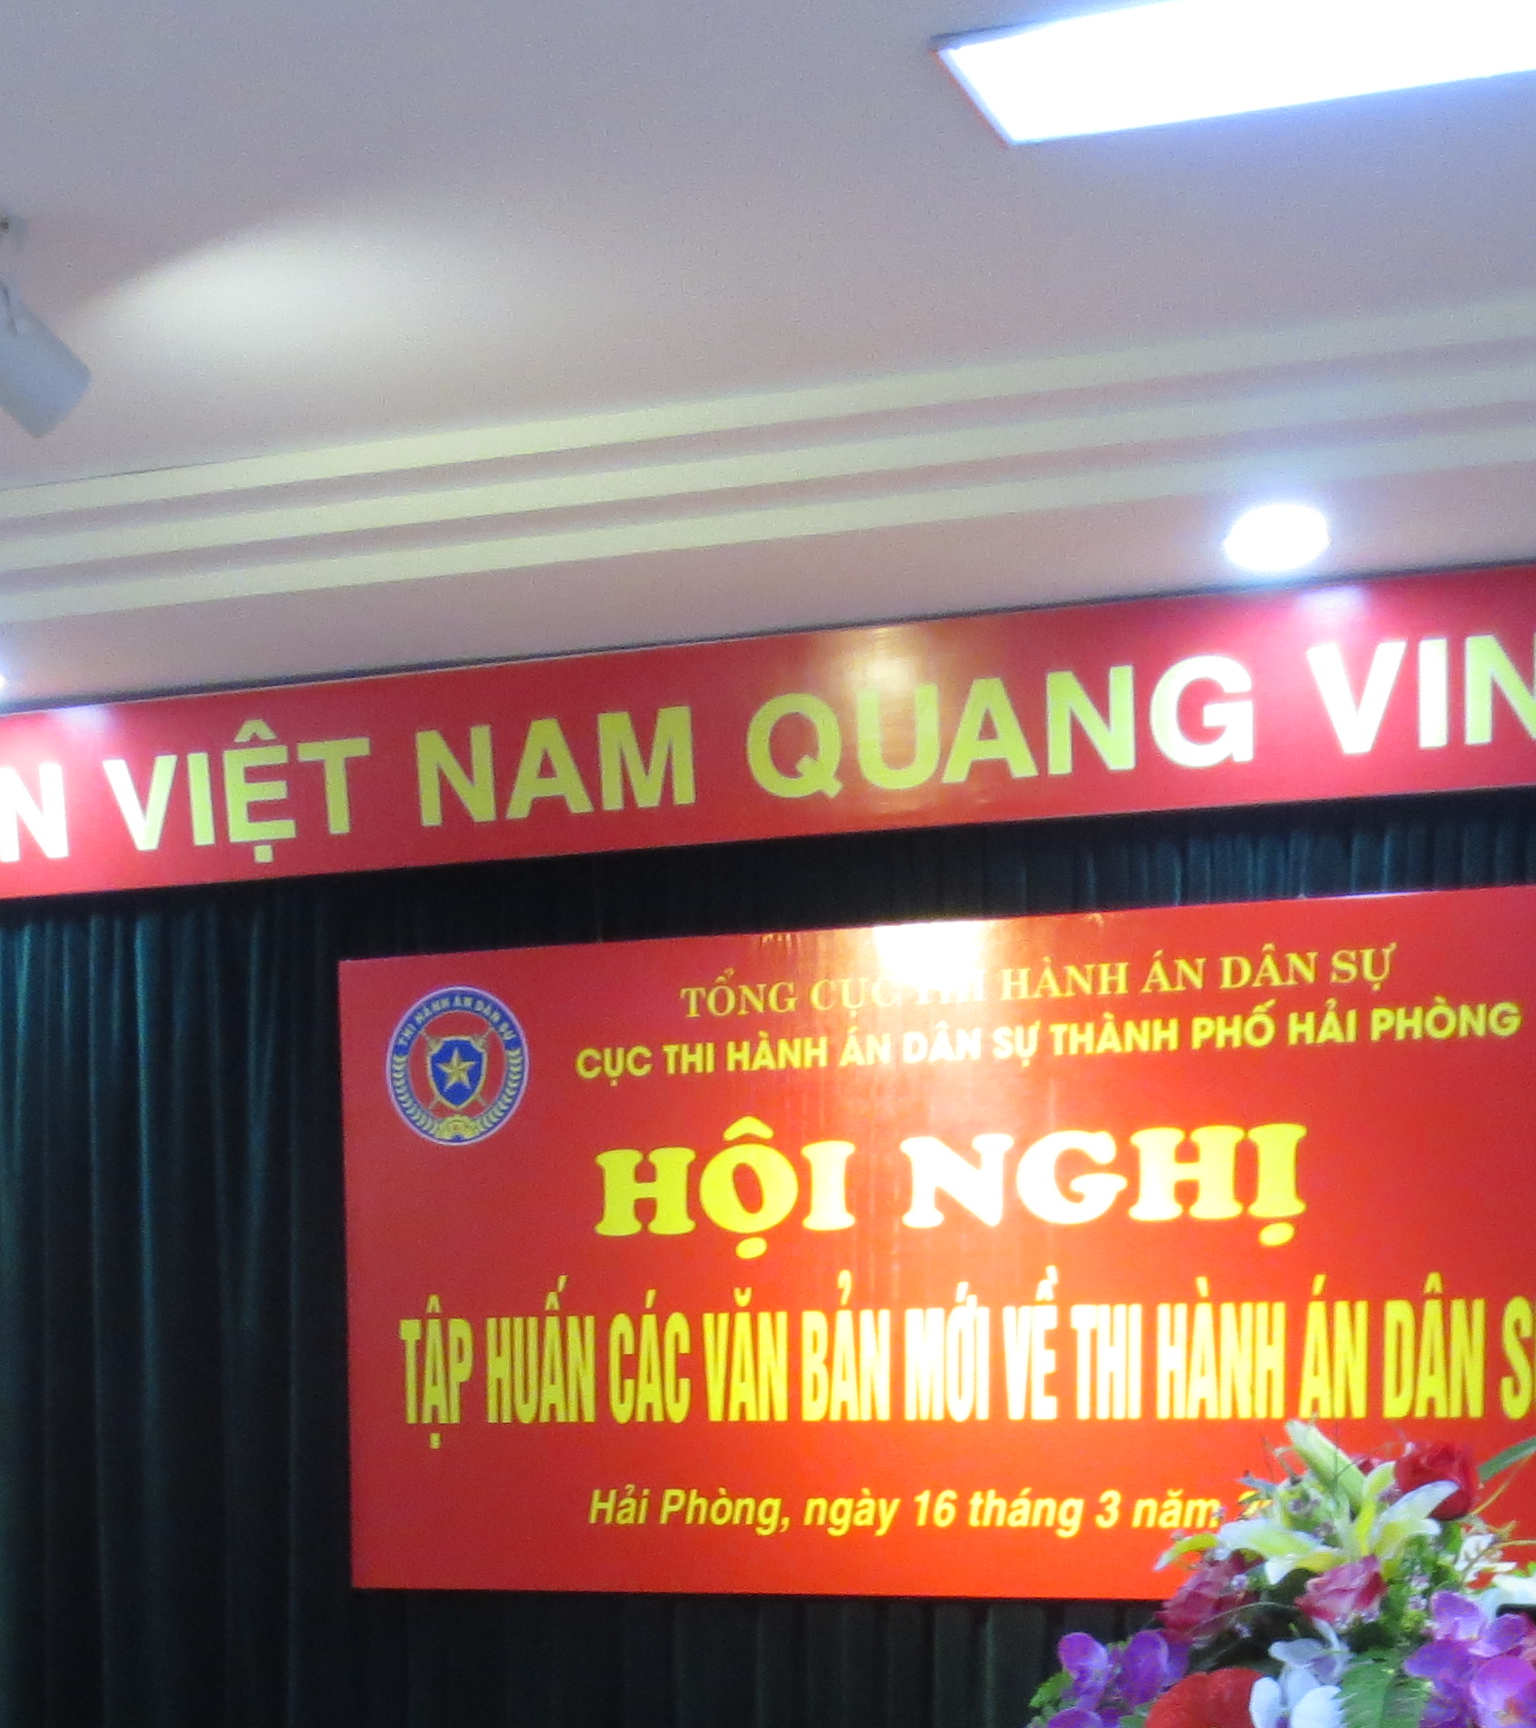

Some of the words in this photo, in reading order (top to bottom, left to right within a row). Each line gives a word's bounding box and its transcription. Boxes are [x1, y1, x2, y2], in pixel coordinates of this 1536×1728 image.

[103, 717, 371, 863] VIỆT
[415, 705, 697, 829] NAM
[746, 655, 1257, 801] QUANG
[680, 967, 798, 1018] TỔNG
[809, 974, 902, 1019] CỤC
[1000, 955, 1129, 1001] HÀNH
[1141, 949, 1206, 994] ÁN
[1219, 942, 1319, 990] DÂN
[1330, 941, 1397, 992] SỰ
[575, 1045, 653, 1087] CỤC
[662, 1042, 716, 1075] THI
[726, 1030, 828, 1072] HÀNH
[839, 1025, 892, 1068] ÁN
[902, 1020, 982, 1064] DÂN
[992, 1019, 1041, 1068] SỰ
[1048, 1011, 1179, 1057] THÀNH
[1191, 998, 1277, 1051] PHỐ
[1287, 997, 1358, 1046] HẢI
[1370, 994, 1523, 1043] PHÒNG
[595, 1116, 856, 1260] HỘI
[899, 1123, 1308, 1247] NGHỊ
[399, 1293, 474, 1450] TẬP
[485, 1274, 596, 1424] HUẤN
[608, 1289, 691, 1424] CÁC
[702, 1286, 789, 1422] VĂN
[801, 1269, 891, 1422] BẢN
[904, 1281, 990, 1423] MỚI
[1002, 1265, 1060, 1422] VỀ
[1070, 1303, 1143, 1421] THI
[1157, 1276, 1286, 1420] HÀNH
[1298, 1274, 1368, 1421] ÁN
[1382, 1272, 1487, 1420] DÂN
[588, 1484, 651, 1526] Hải
[659, 1487, 792, 1537] Phòng,
[803, 1487, 901, 1538] ngày
[914, 1489, 959, 1529] 16
[968, 1487, 1085, 1539] tháng
[1095, 1489, 1123, 1529] 3
[1131, 1488, 1223, 1529] năm
